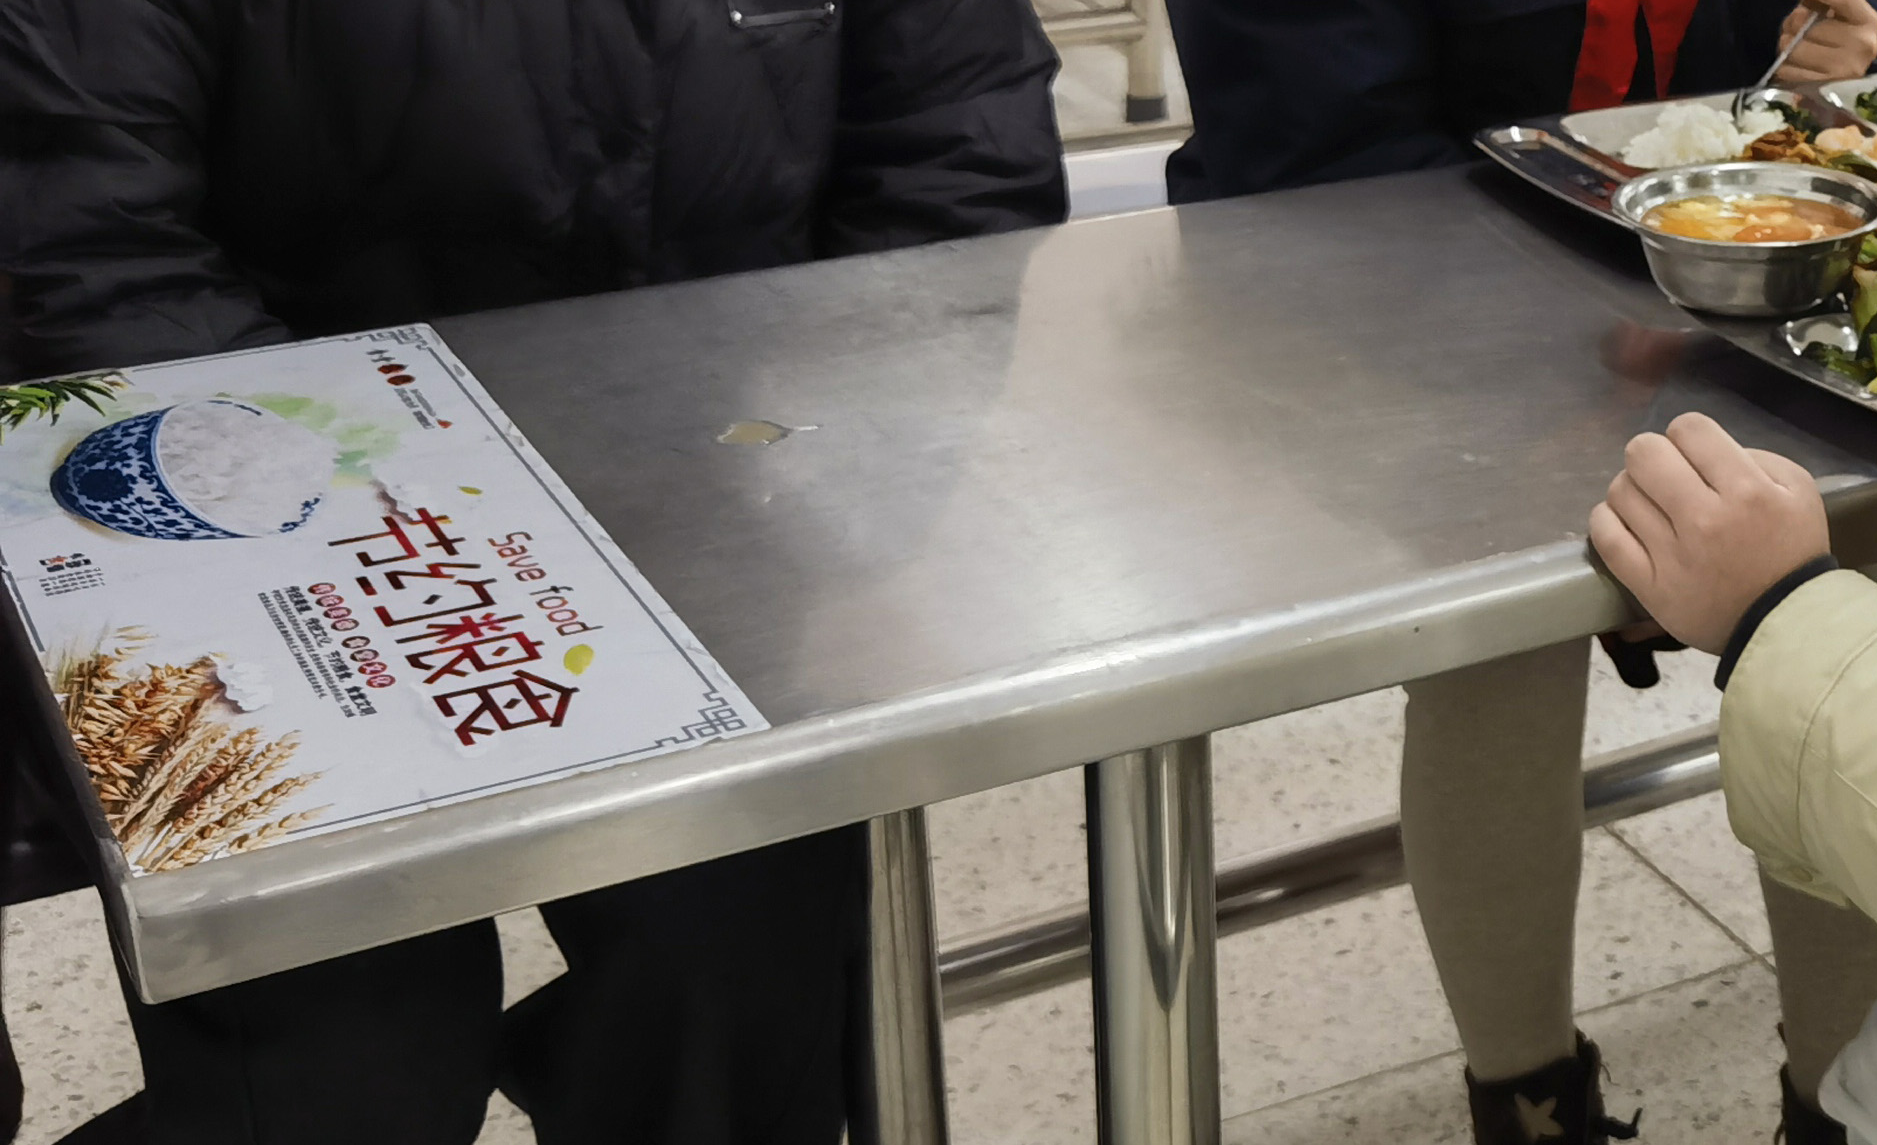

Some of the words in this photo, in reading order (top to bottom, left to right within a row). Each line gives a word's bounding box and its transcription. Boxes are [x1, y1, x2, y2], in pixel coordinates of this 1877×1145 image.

[327, 507, 580, 746] 节约粮食
[487, 531, 547, 582] Save
[529, 585, 605, 636] food
